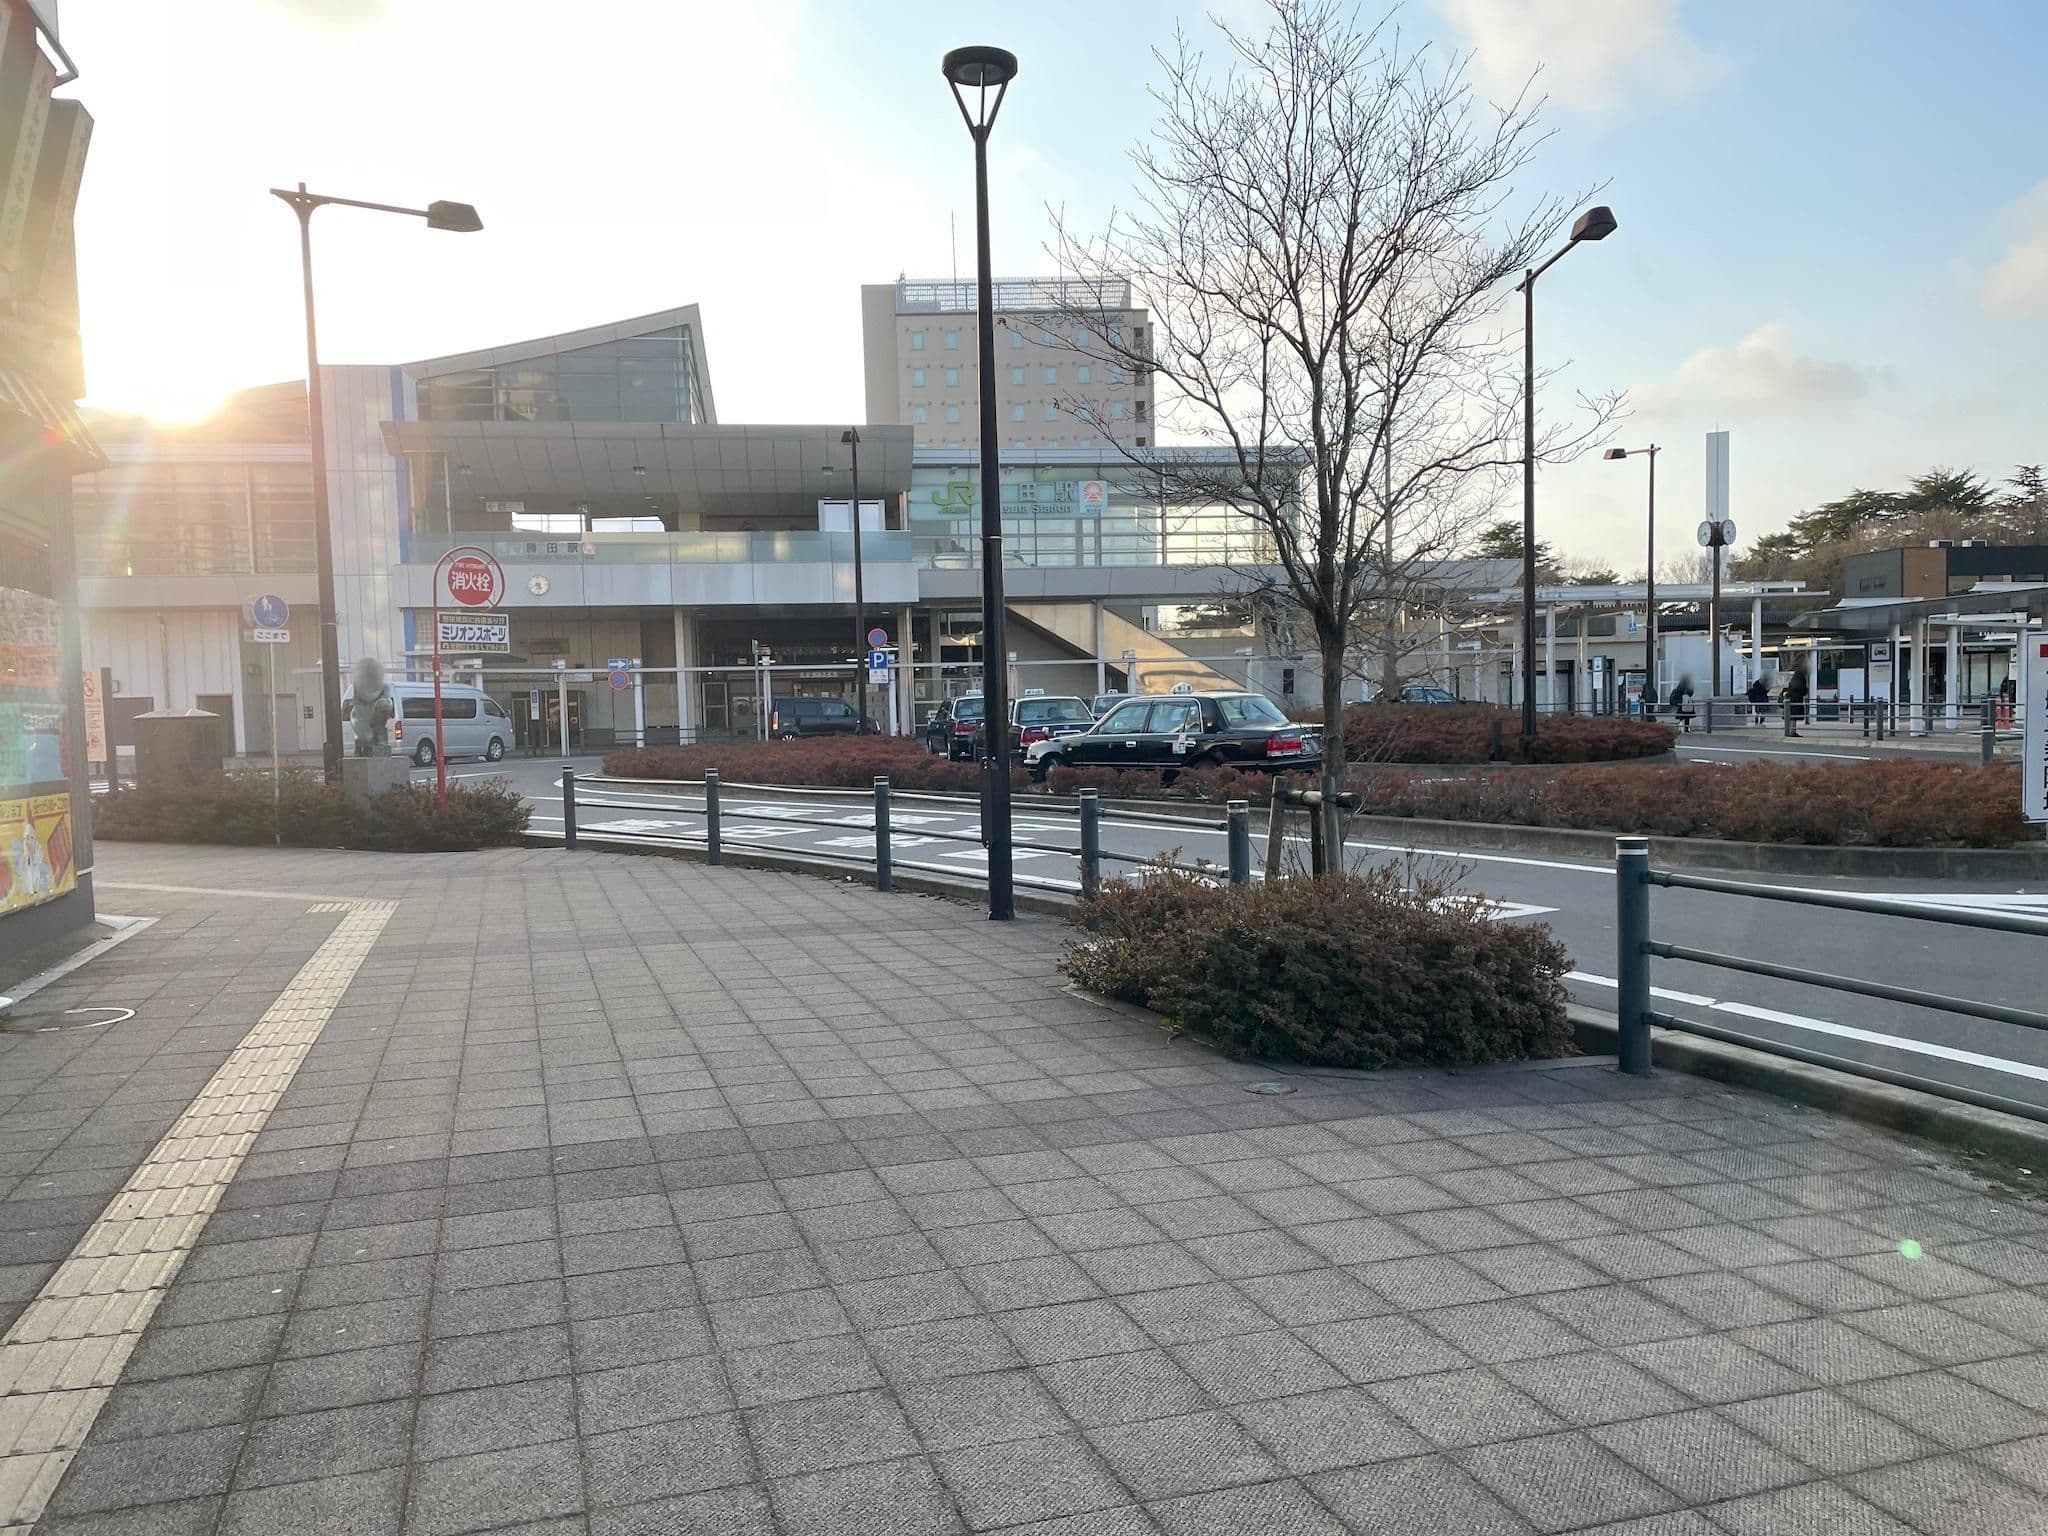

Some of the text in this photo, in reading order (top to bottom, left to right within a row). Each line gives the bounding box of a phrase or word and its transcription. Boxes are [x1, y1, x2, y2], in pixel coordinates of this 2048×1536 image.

[932, 481, 976, 506] JR
[1032, 503, 1073, 513] Station
[451, 571, 491, 592] 消火栓
[256, 631, 287, 640] ここまで
[441, 625, 506, 642] ミリオンスポーツ
[873, 652, 884, 668] P
